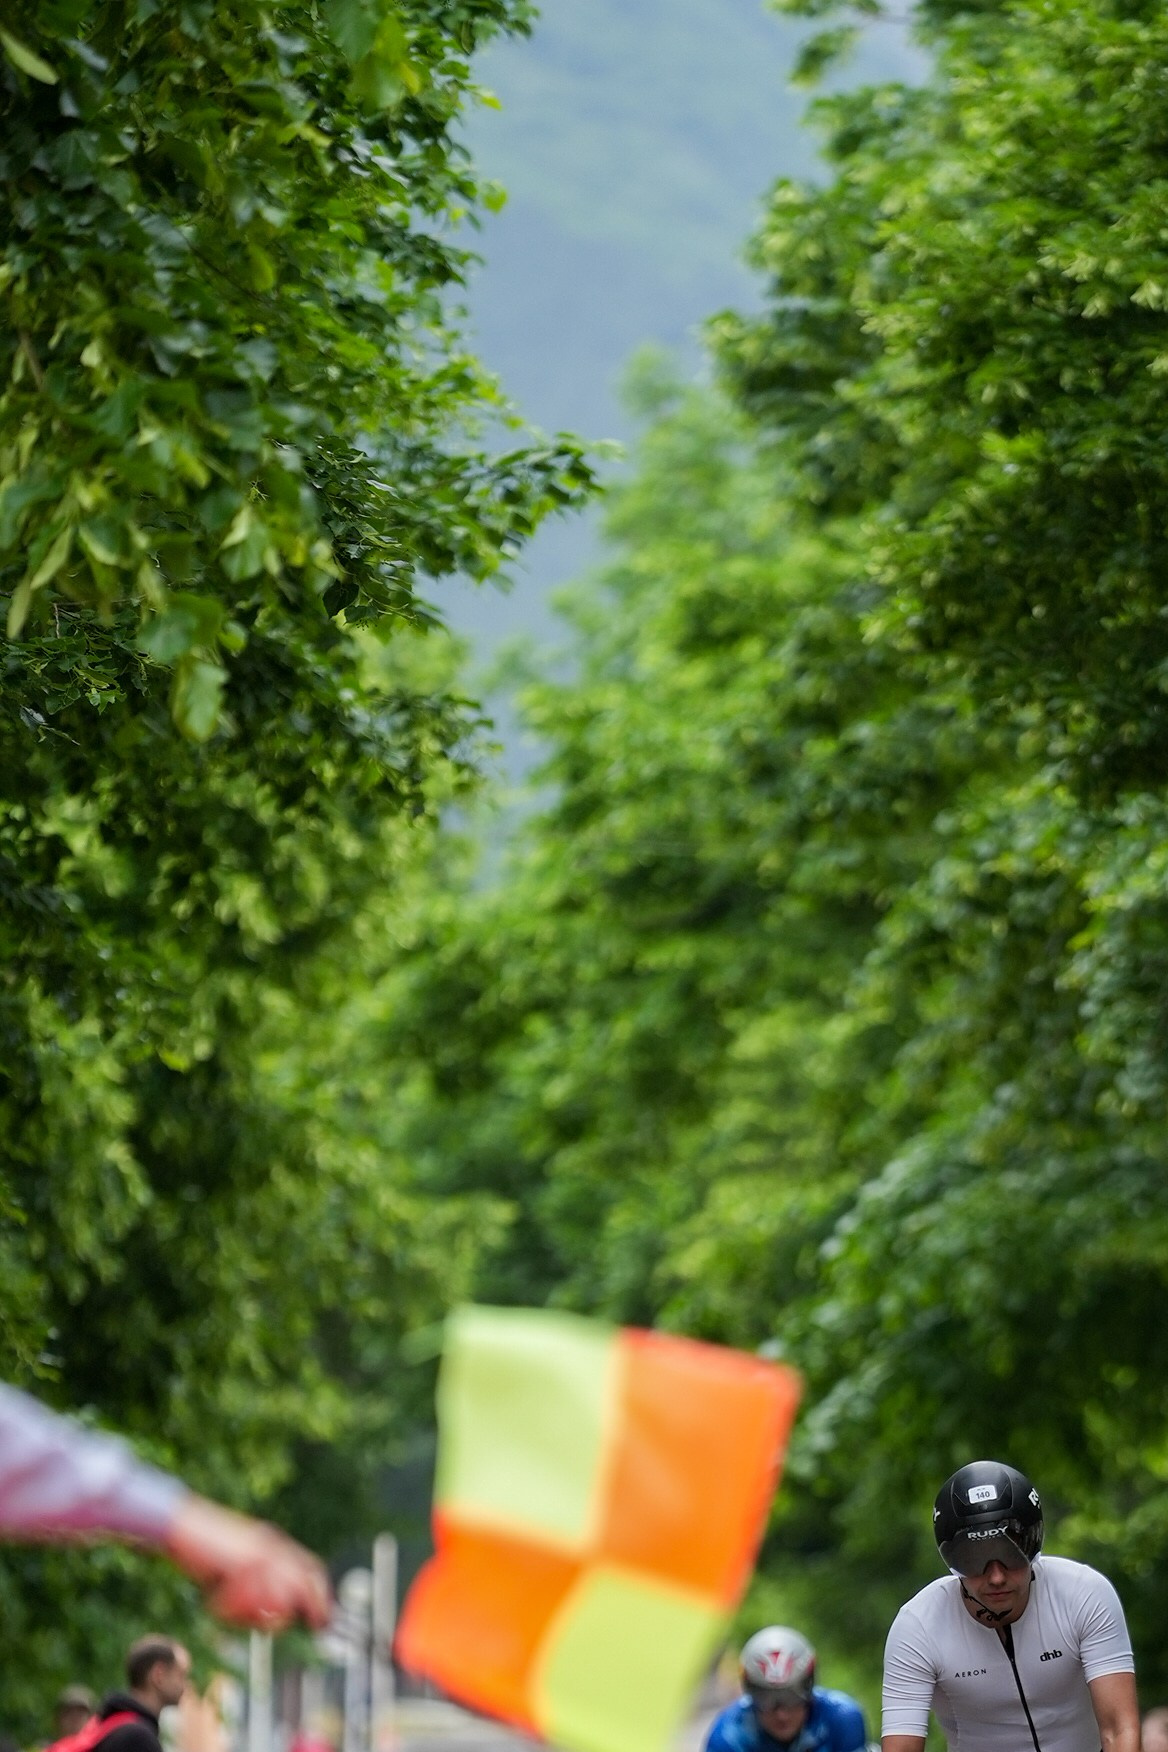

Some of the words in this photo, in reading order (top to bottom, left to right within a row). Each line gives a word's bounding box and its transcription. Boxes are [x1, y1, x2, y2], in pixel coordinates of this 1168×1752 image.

[976, 1490, 990, 1500] 140
[967, 1526, 1008, 1538] RUDY
[1040, 1649, 1063, 1662] dhb
[955, 1668, 987, 1678] AERON
